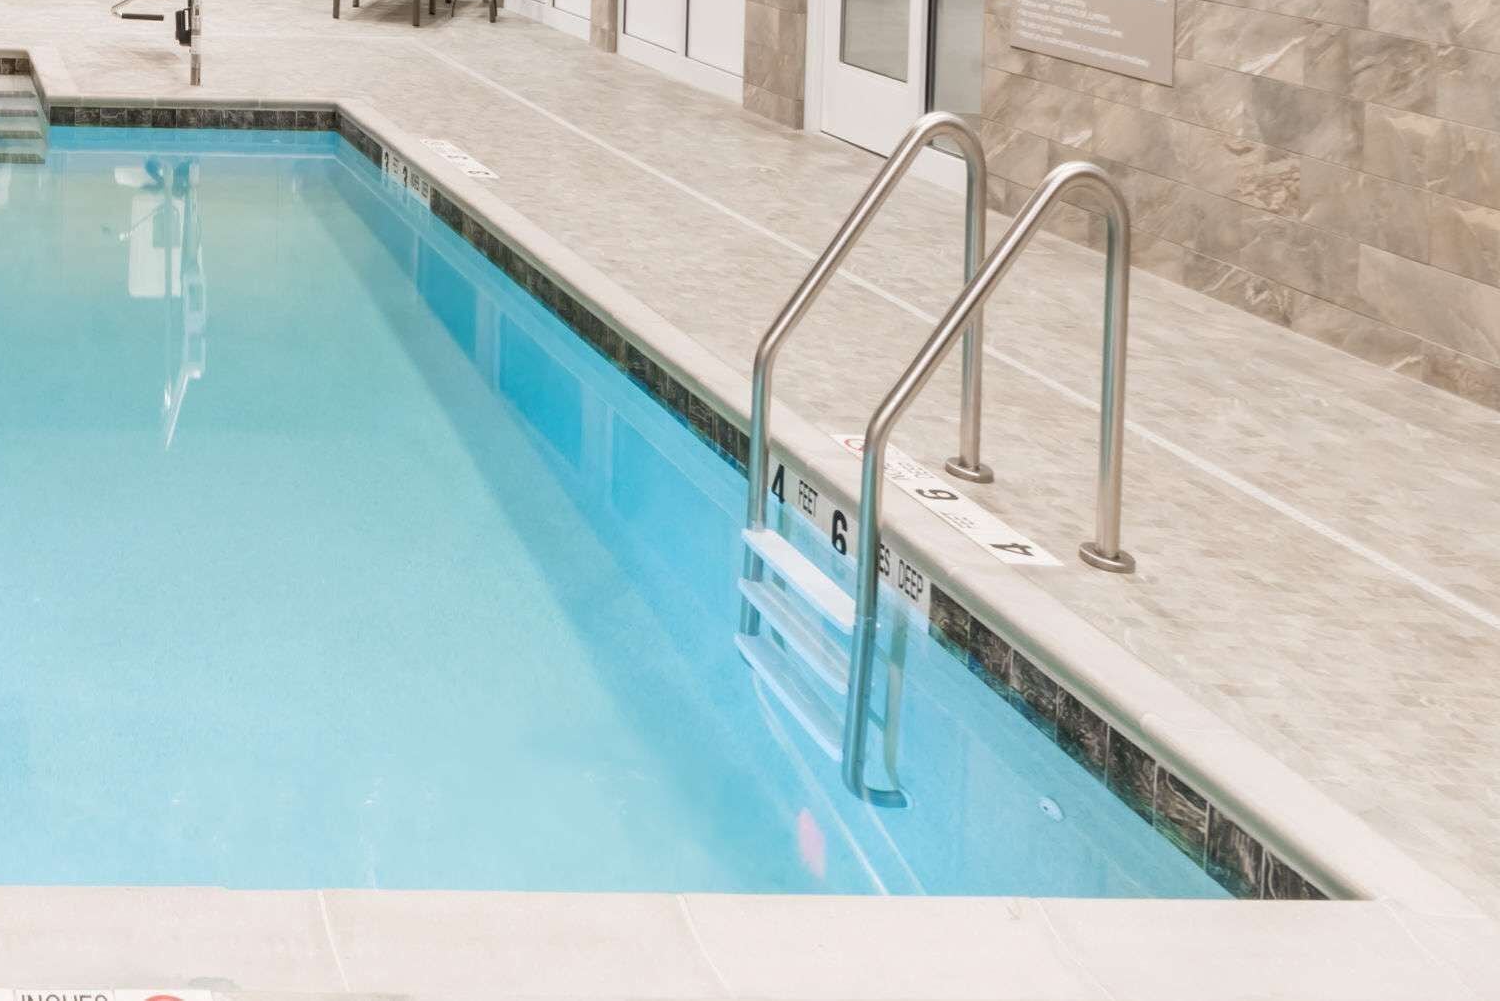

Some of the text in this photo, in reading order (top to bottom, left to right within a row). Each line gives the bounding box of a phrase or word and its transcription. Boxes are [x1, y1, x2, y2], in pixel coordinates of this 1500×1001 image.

[771, 464, 785, 505] 4
[798, 479, 819, 519] FEET
[832, 509, 848, 556] 6
[898, 558, 924, 603] DEEP
